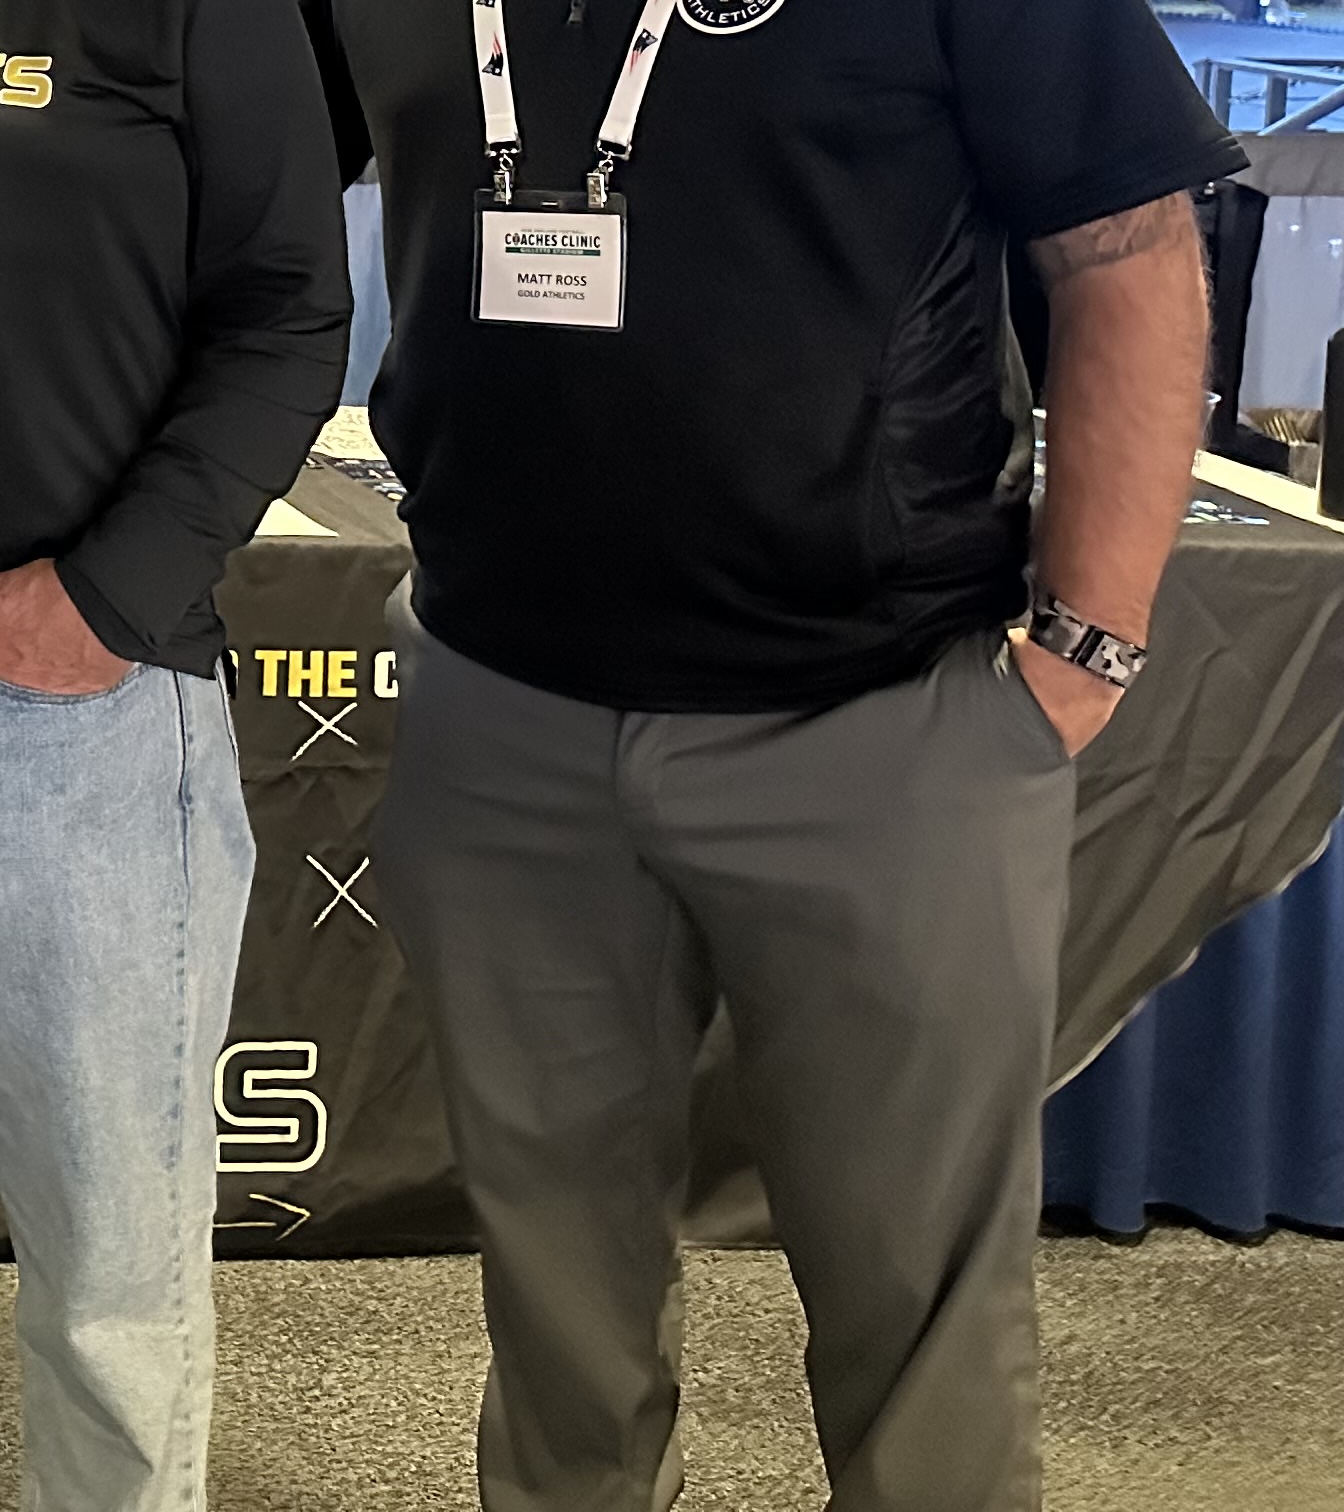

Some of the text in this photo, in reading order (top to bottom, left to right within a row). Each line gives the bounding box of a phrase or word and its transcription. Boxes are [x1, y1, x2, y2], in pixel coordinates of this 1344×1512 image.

[505, 233, 601, 248] COACHES CLINIC
[517, 273, 587, 286] MATT ROSS
[517, 290, 540, 298] GOLD
[254, 650, 358, 698] THE
